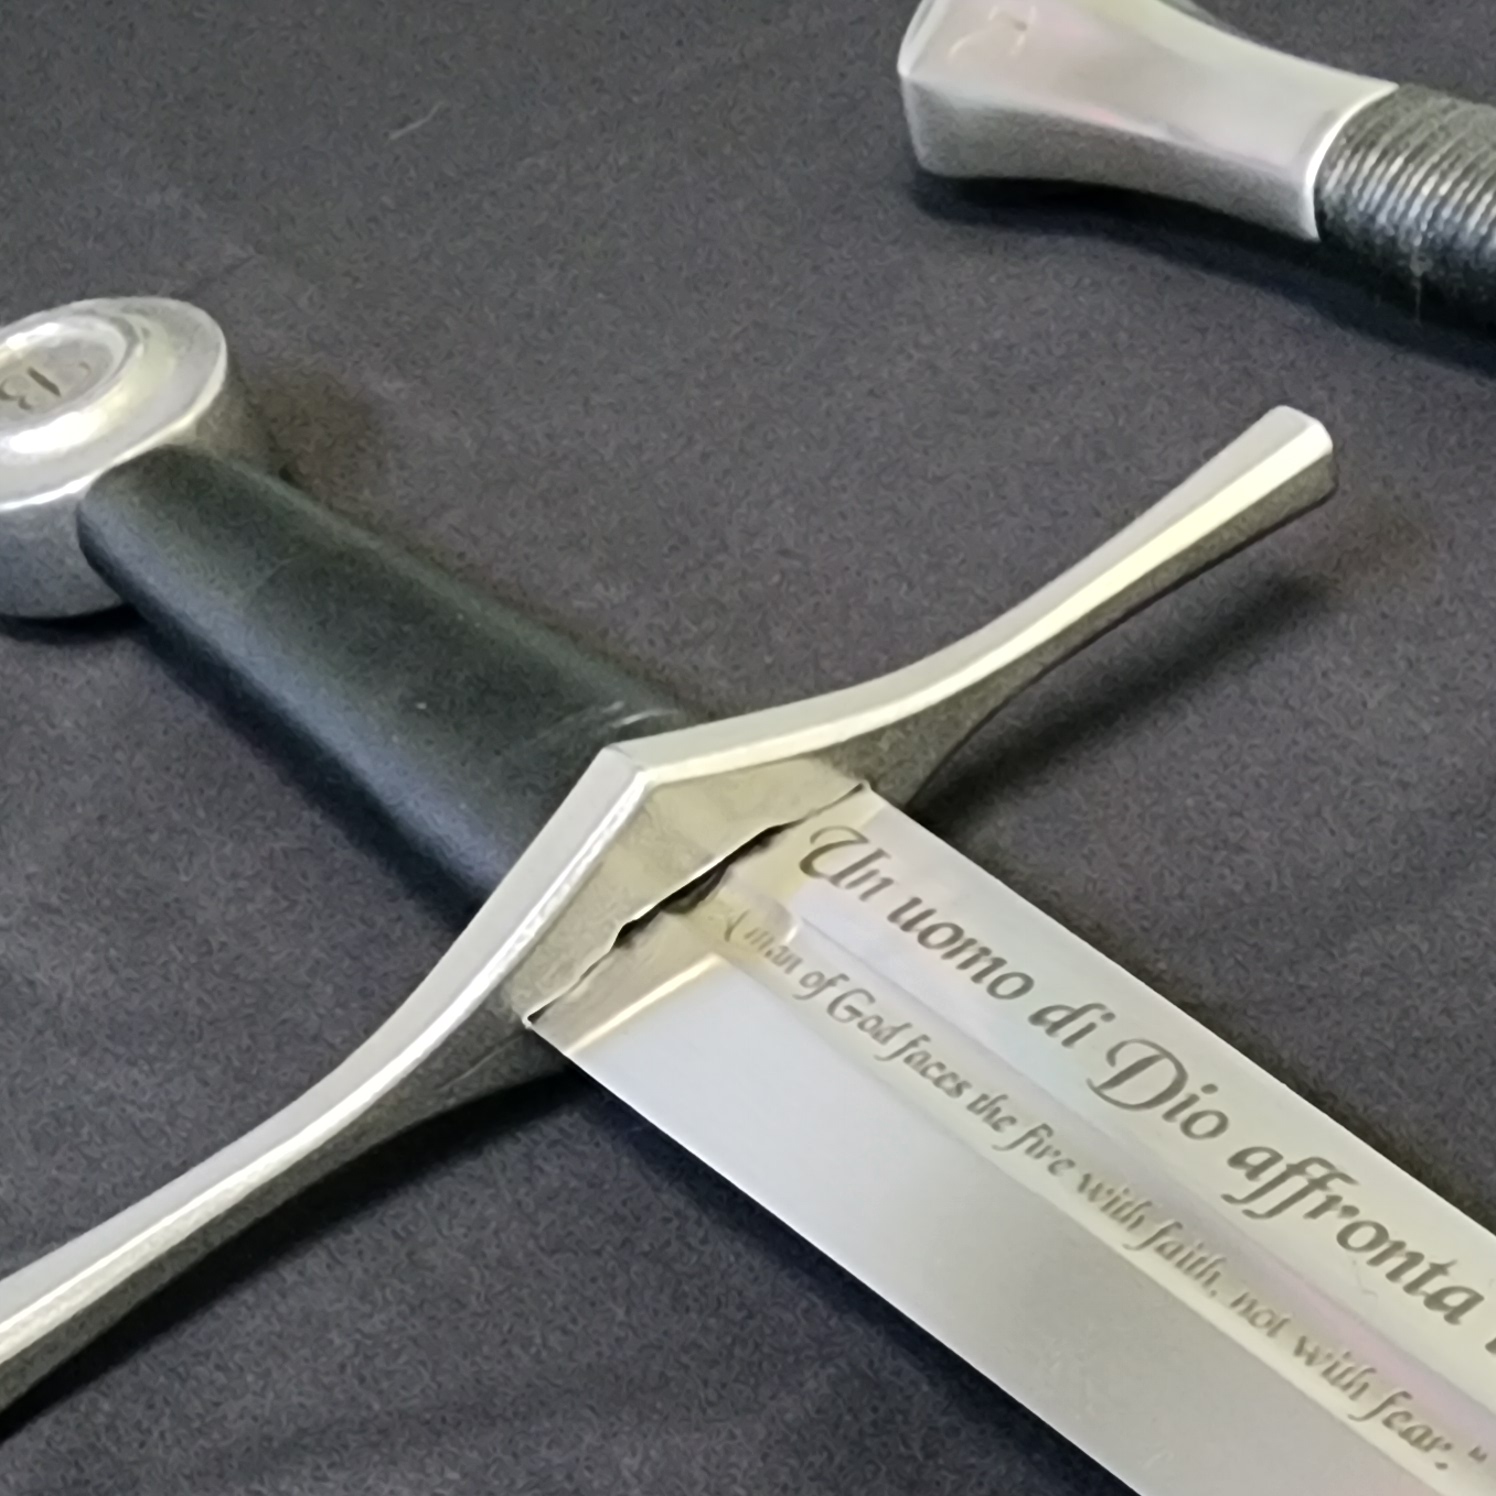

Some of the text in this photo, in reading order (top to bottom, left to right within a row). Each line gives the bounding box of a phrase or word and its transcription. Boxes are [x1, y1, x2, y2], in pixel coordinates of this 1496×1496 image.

[792, 970, 851, 1001] of
[826, 988, 912, 1045] God
[798, 825, 894, 902] Un
[887, 897, 1035, 1000] uomo
[1028, 1002, 1116, 1049] di
[1086, 1038, 1229, 1140] Dio
[1221, 1145, 1485, 1325] affronta
[873, 1034, 973, 1098] faces
[966, 1093, 1017, 1133] the
[991, 1123, 1076, 1176] fire
[1077, 1173, 1152, 1231] with
[1229, 1292, 1291, 1337] not
[1293, 1335, 1377, 1400] with
